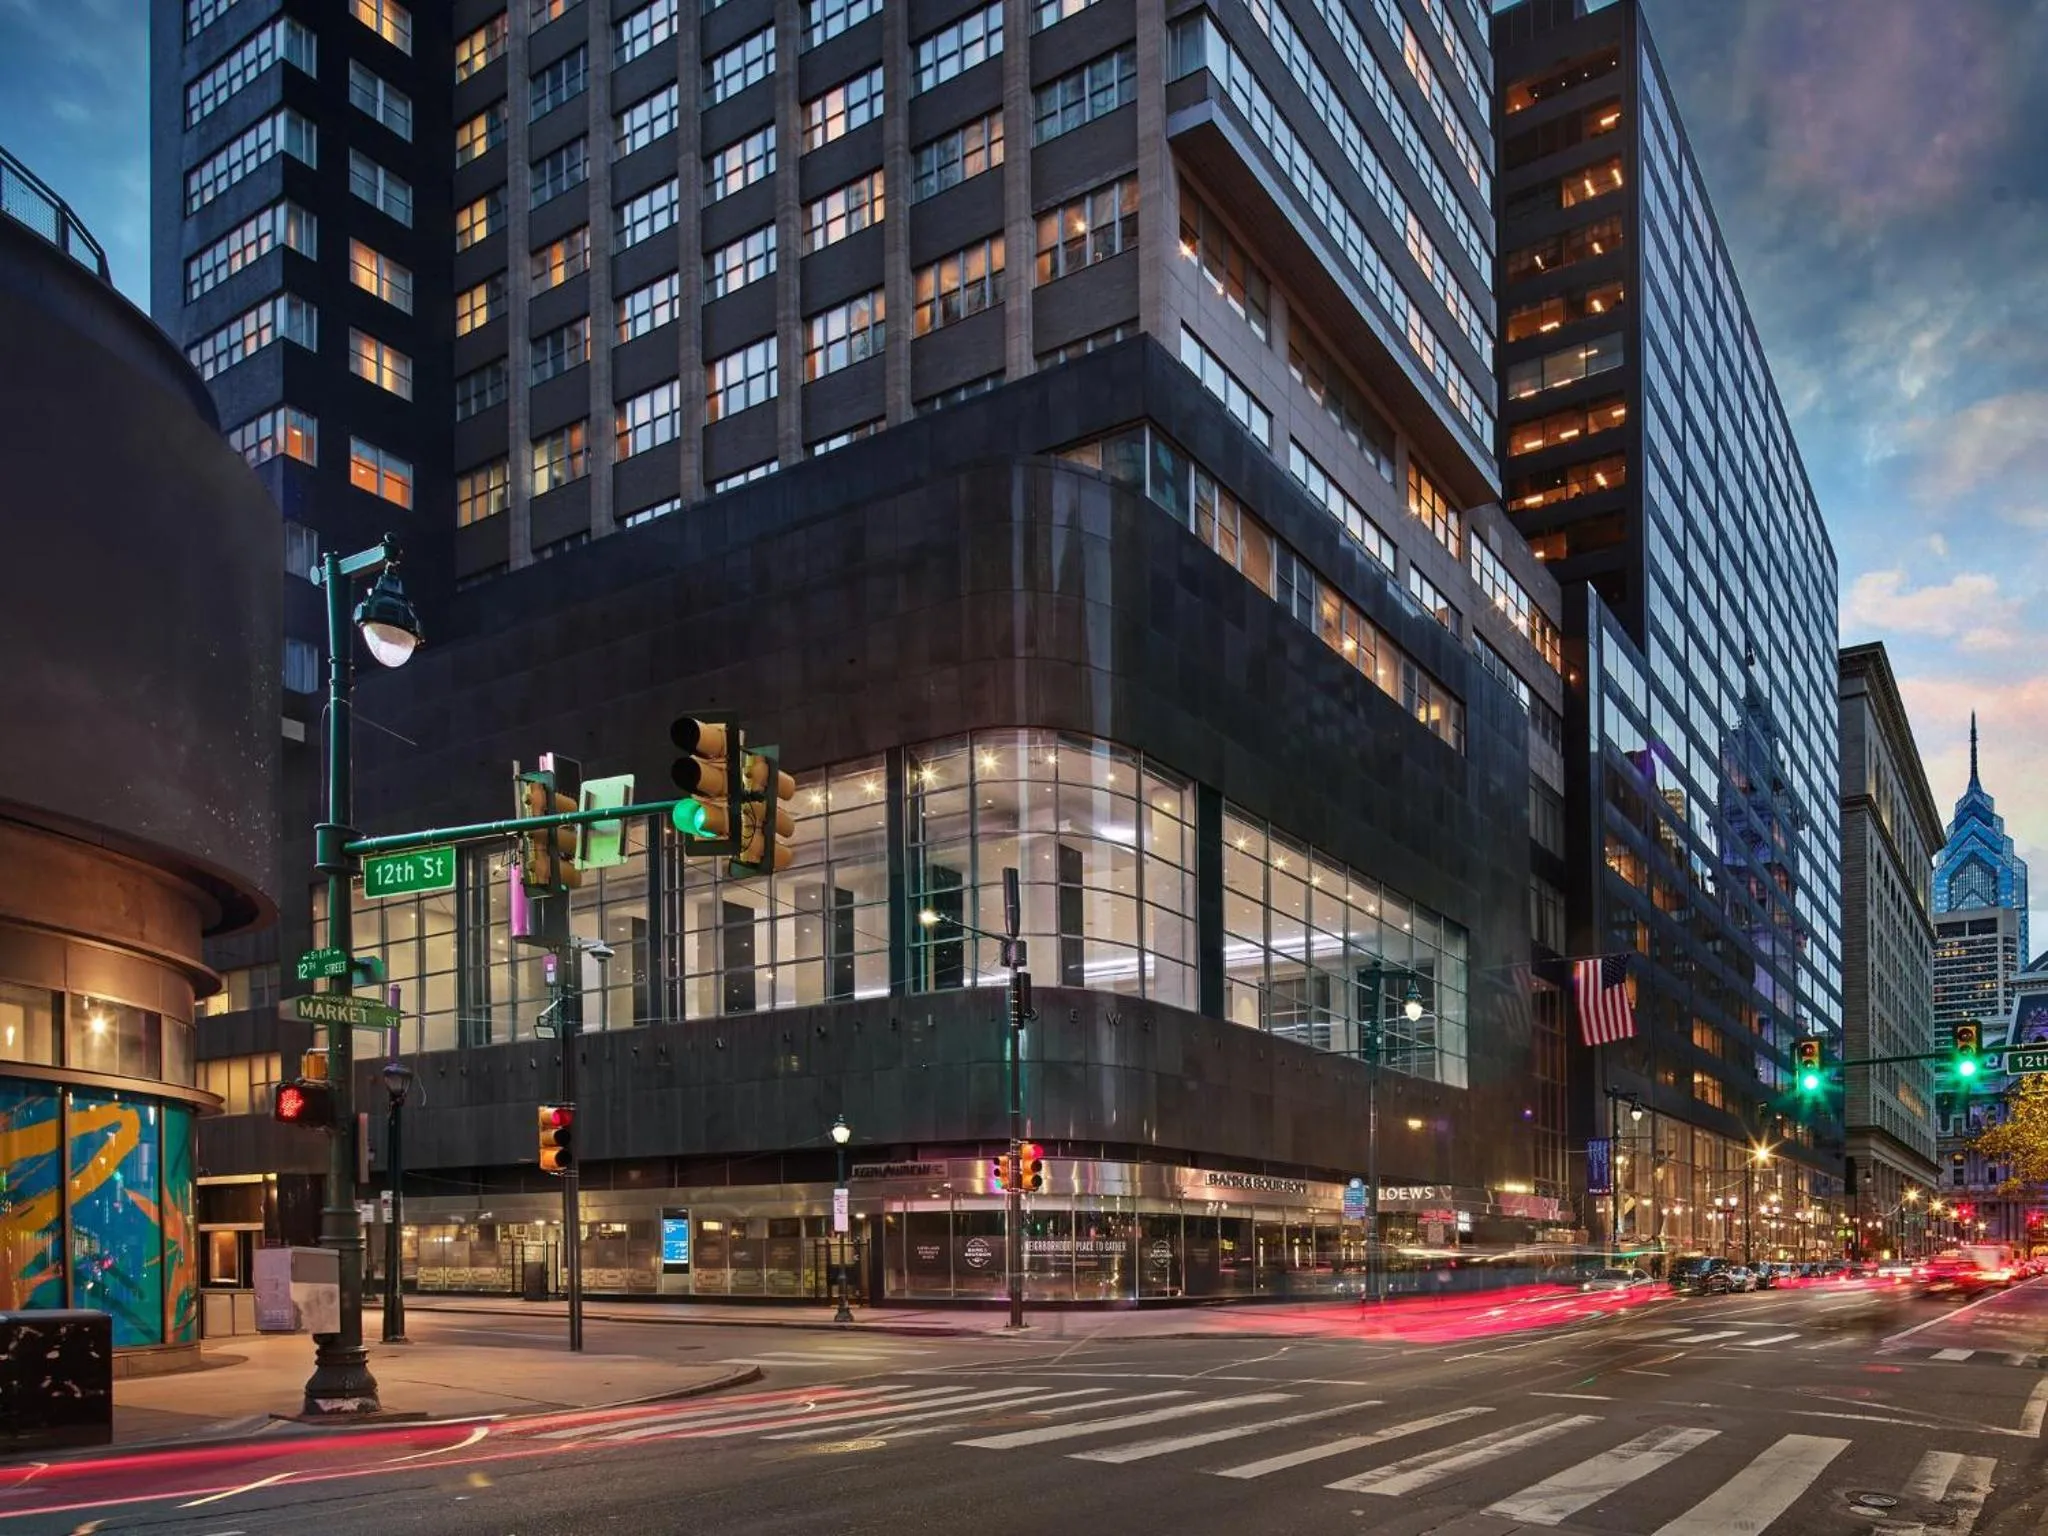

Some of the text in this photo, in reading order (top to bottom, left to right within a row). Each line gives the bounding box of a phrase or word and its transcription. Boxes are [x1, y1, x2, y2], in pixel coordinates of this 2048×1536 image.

[375, 856, 444, 886] 12th St
[324, 961, 347, 975] STREET
[299, 1000, 398, 1027] MARKET ST
[1378, 1186, 1435, 1201] LOEWS
[1075, 1240, 1094, 1251] PLACE
